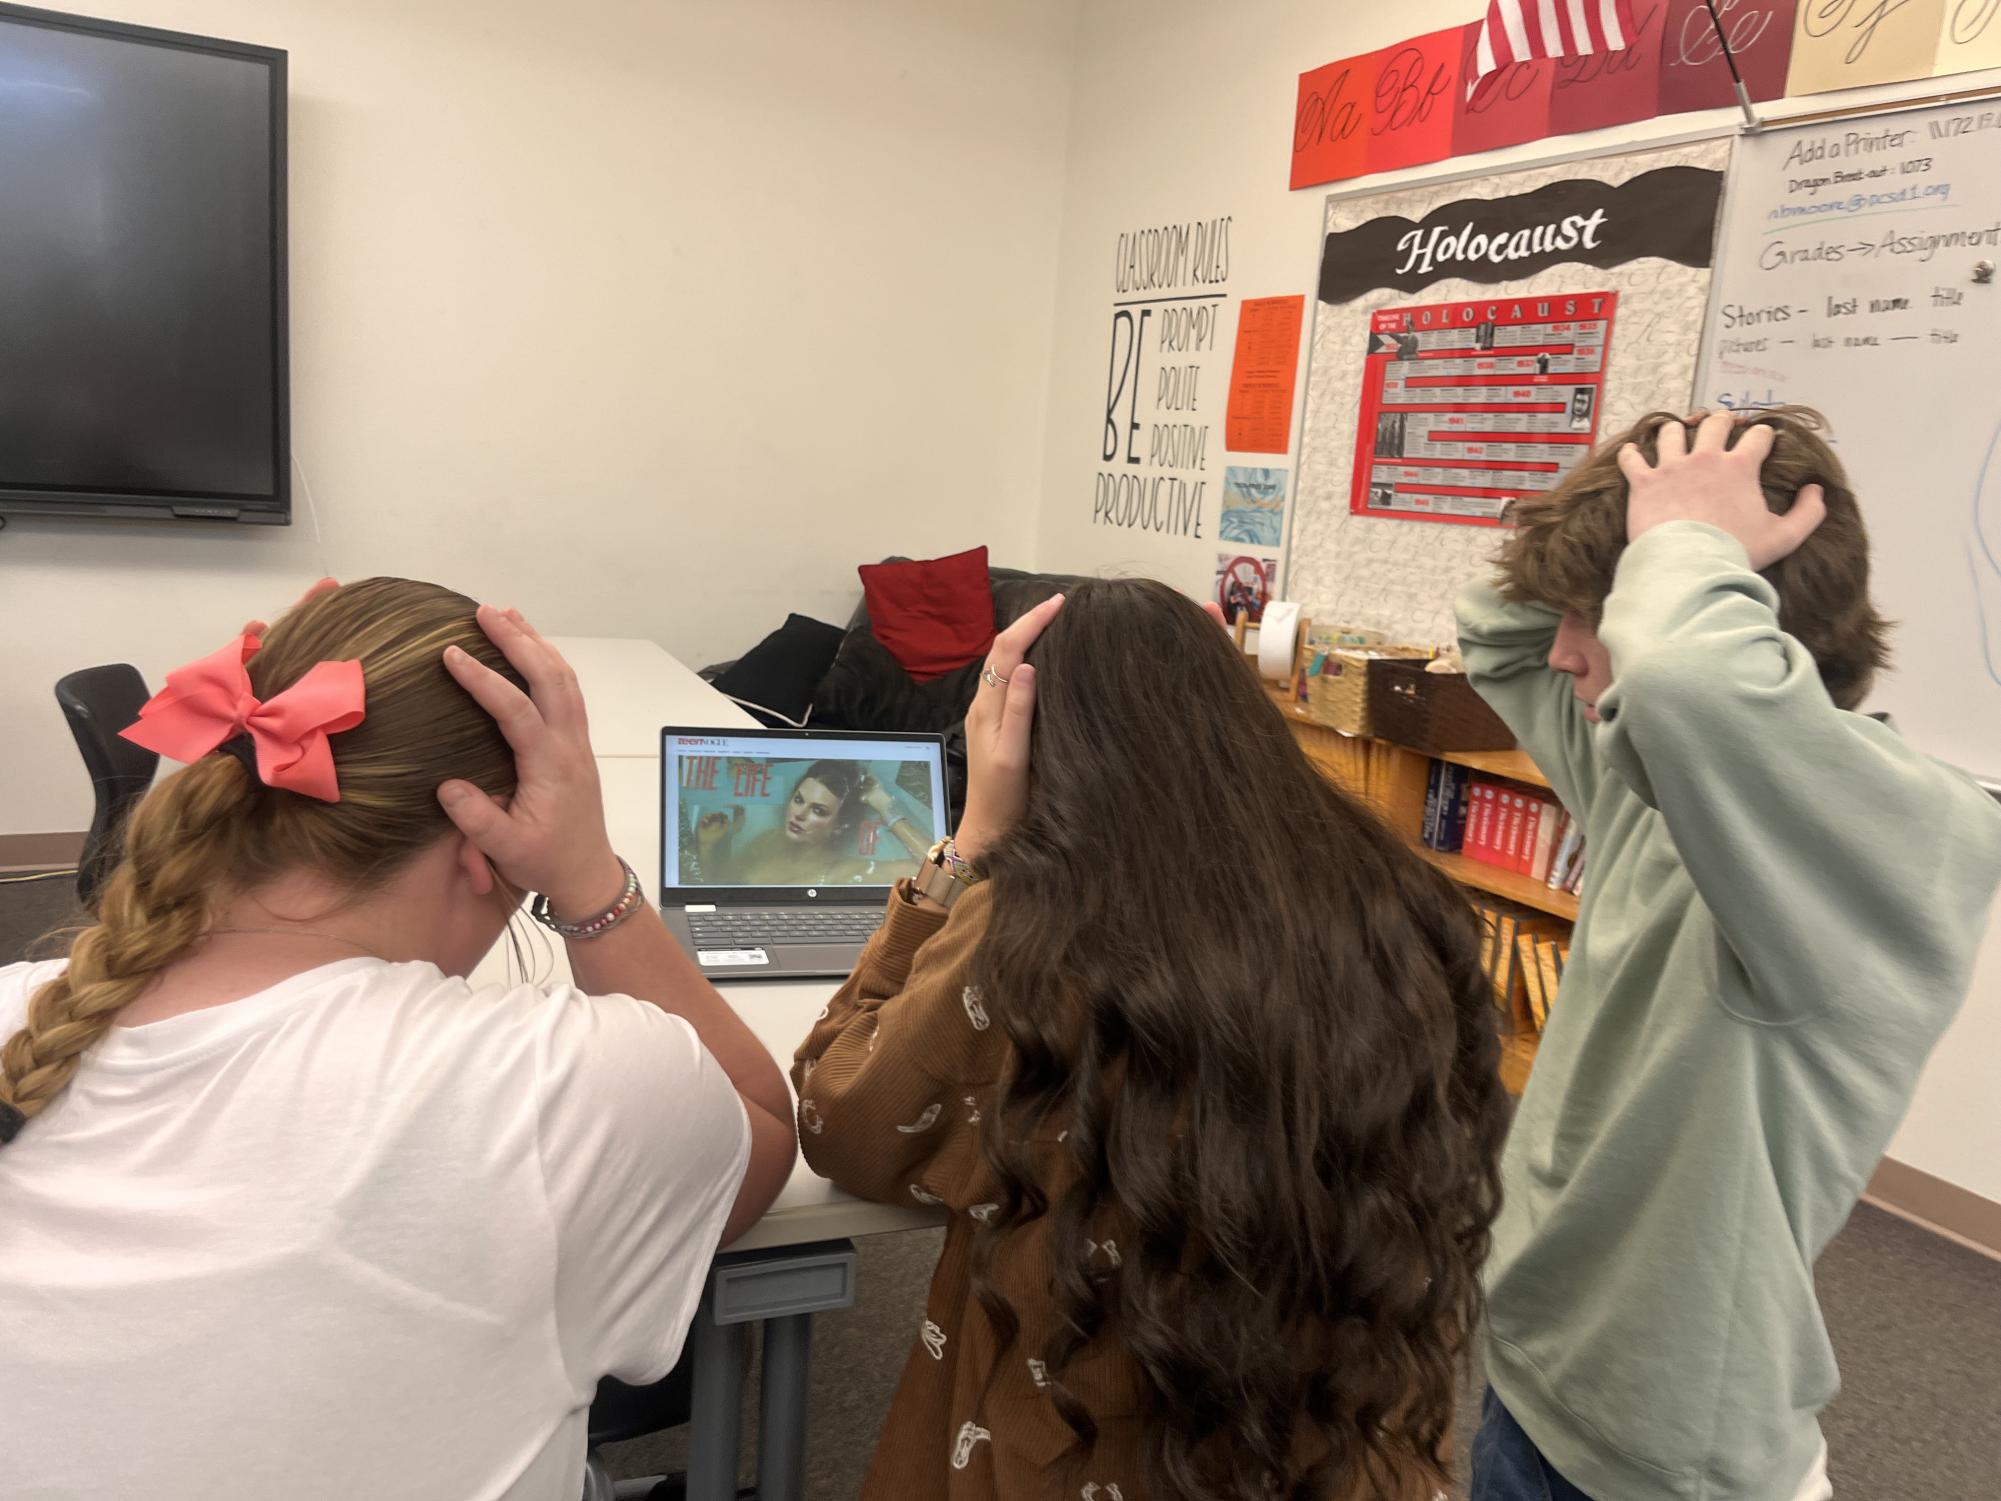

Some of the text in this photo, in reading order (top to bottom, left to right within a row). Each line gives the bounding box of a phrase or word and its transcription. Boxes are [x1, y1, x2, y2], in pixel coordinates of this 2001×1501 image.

[1782, 137, 1826, 171] Add
[1116, 215, 1233, 293] CLASSROOM RULES
[1395, 208, 1608, 274] Holocaust
[1759, 241, 1845, 271] Grades
[1160, 304, 1219, 352] PROMPT
[1402, 298, 1605, 328] HOLOCAUST
[1721, 304, 1792, 328] Stories
[1102, 308, 1152, 464] BE
[1157, 365, 1200, 412] POLITE
[1150, 424, 1209, 471] POSITIVE
[1093, 472, 1206, 539] PRODUCTIVE
